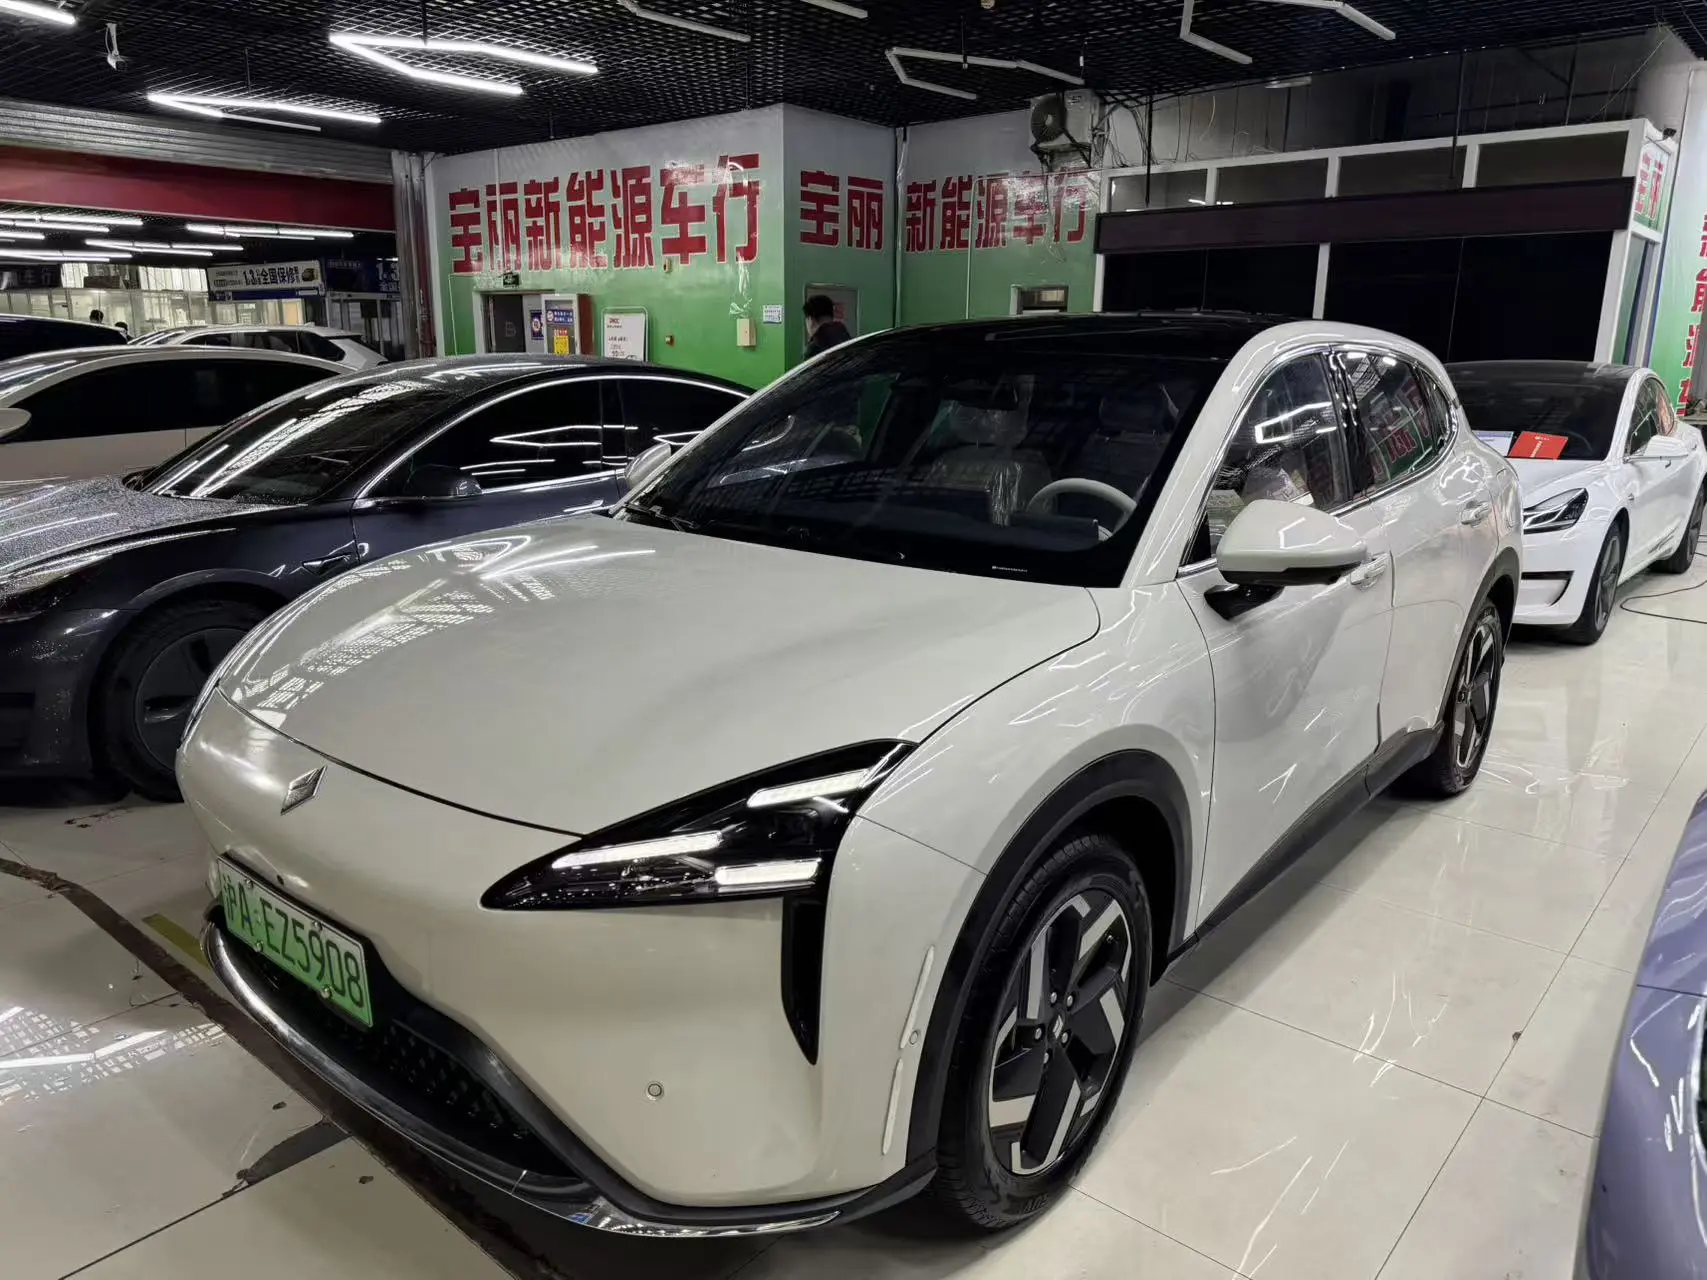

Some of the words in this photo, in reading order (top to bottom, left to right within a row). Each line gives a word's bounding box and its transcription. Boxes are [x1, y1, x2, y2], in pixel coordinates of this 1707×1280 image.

[448, 153, 760, 273] 宝丽新能源车行
[799, 170, 884, 251] 宝丽
[905, 171, 1089, 252] 新能源车行
